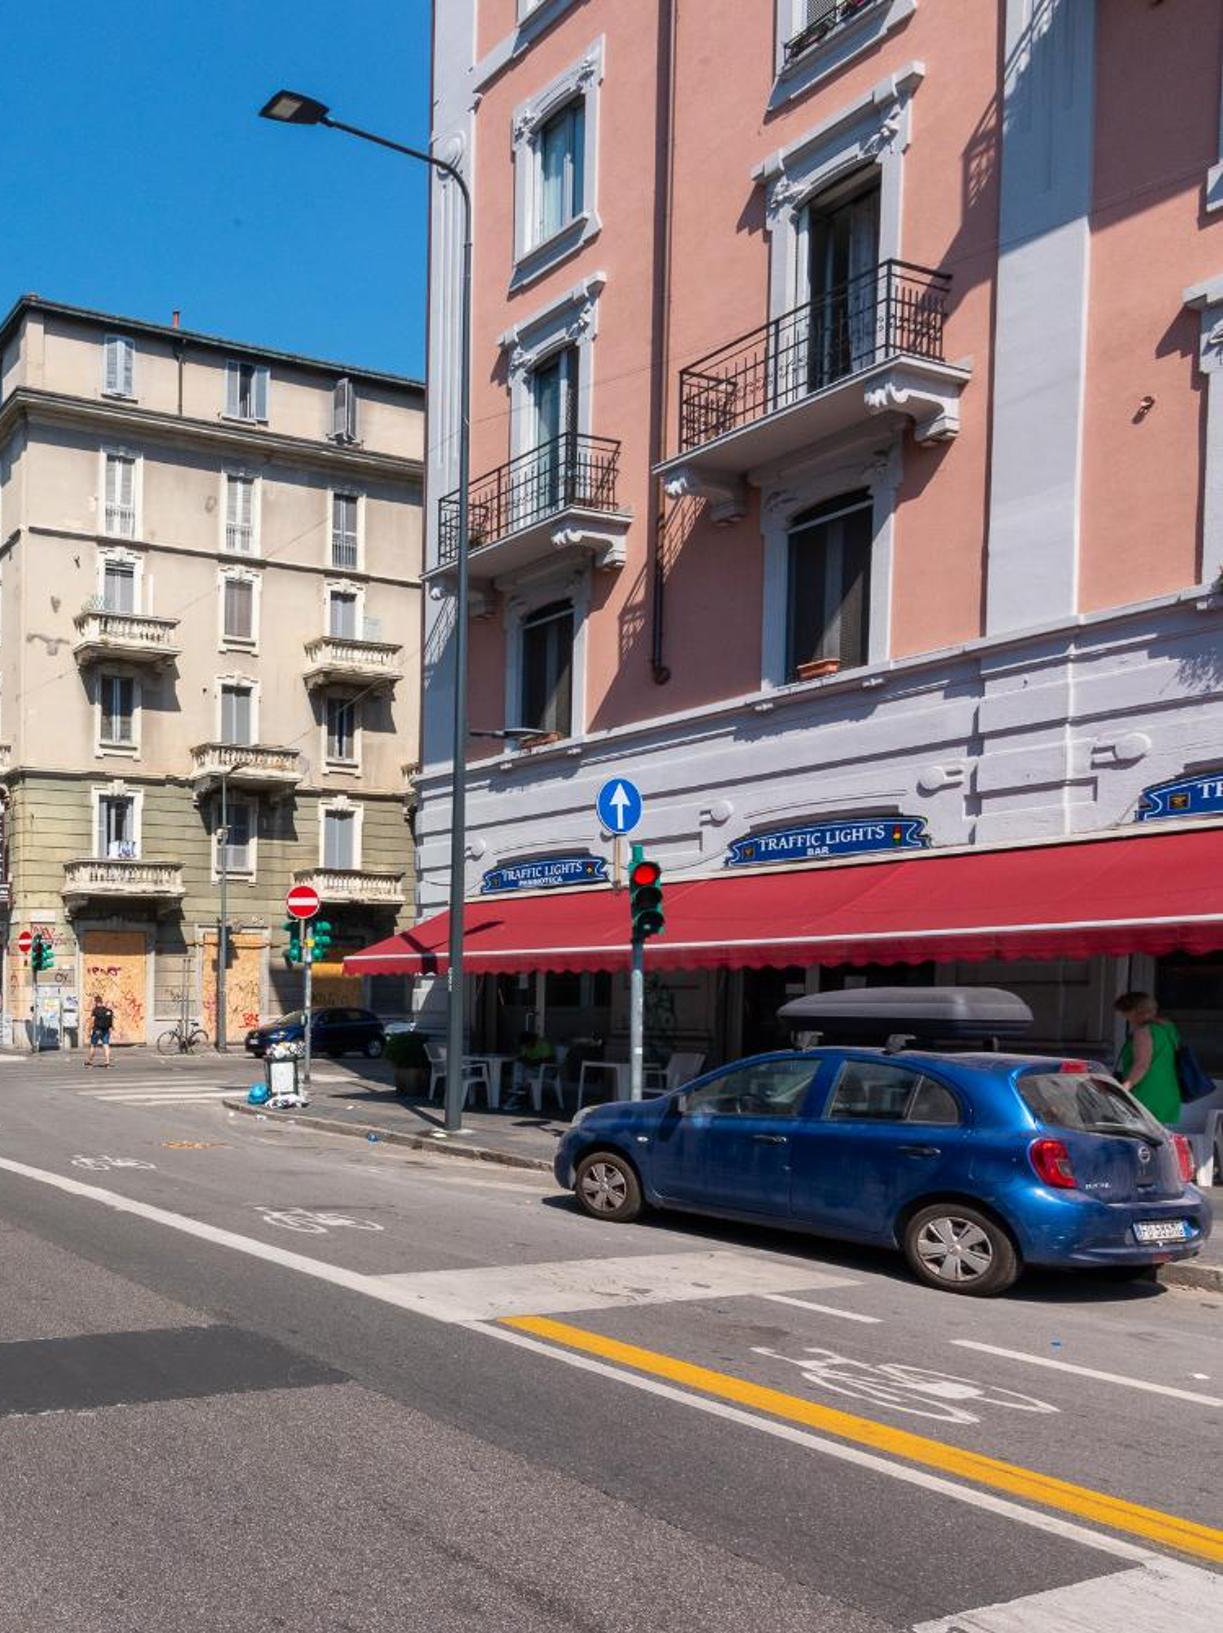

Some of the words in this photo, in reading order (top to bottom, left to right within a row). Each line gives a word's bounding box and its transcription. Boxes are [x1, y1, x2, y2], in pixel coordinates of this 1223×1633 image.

[757, 832, 822, 851] TRAFFIC
[826, 825, 885, 844] LIGHTS
[807, 847, 829, 856] BAR
[503, 866, 543, 881] TRAFFIC
[545, 861, 583, 875] LIGHTS
